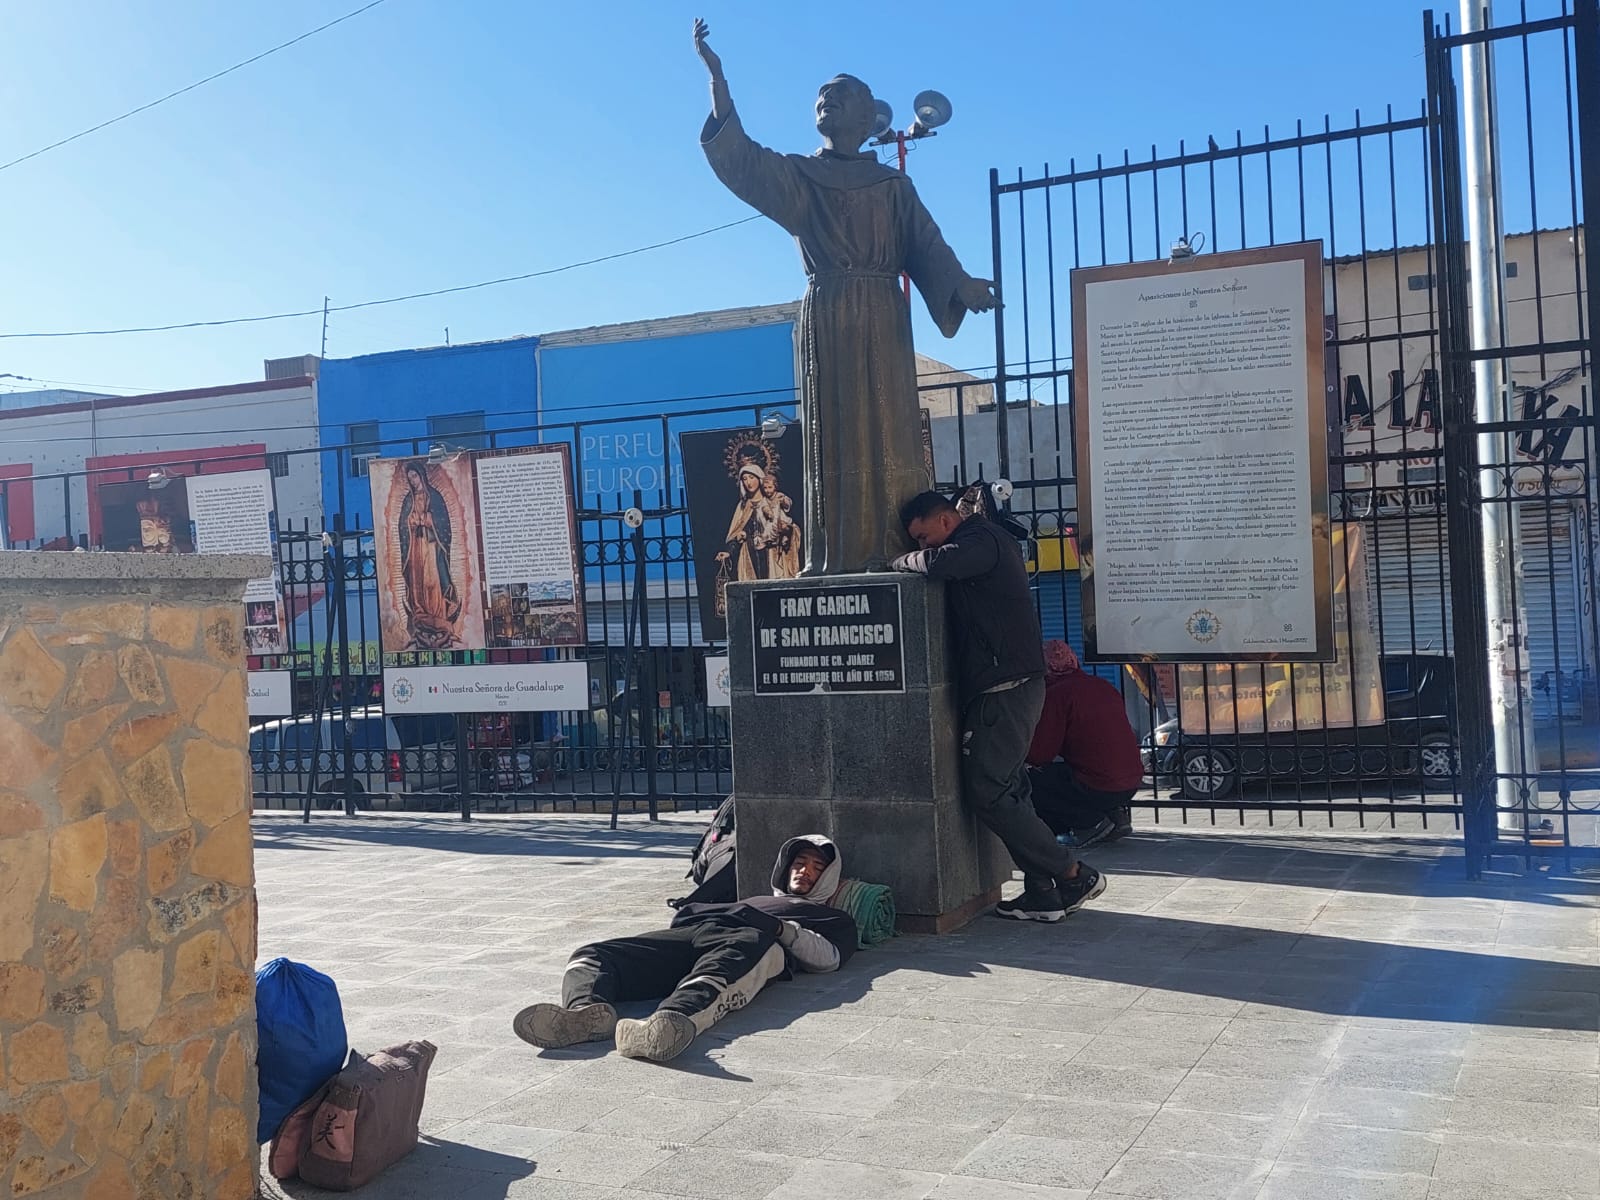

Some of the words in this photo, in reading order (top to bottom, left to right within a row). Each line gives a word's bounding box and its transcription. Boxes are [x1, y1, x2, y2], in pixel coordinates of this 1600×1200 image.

[1138, 290, 1181, 302] Apariciones
[1182, 288, 1192, 297] de
[1192, 286, 1221, 296] Nuestra
[1222, 283, 1248, 294] Señora
[780, 597, 812, 617] FRAY
[816, 594, 870, 616] GARCIA
[760, 628, 777, 648] DE
[781, 627, 809, 647] SAN
[814, 624, 894, 646] FRANCISCO
[780, 656, 818, 668] FUNDADOR
[821, 656, 829, 666] DE
[832, 656, 844, 666] CD.
[846, 653, 875, 666] JUÁREZ
[763, 673, 770, 684] EL
[780, 673, 788, 684] DE
[791, 672, 830, 683] DICIEMBRE
[832, 672, 844, 682] DEL
[846, 669, 862, 682] AÑO
[864, 670, 873, 682] DE
[442, 683, 473, 694] Nuestra
[475, 682, 503, 693] Señora
[504, 681, 515, 692] de
[516, 681, 564, 693] Guadalupe
